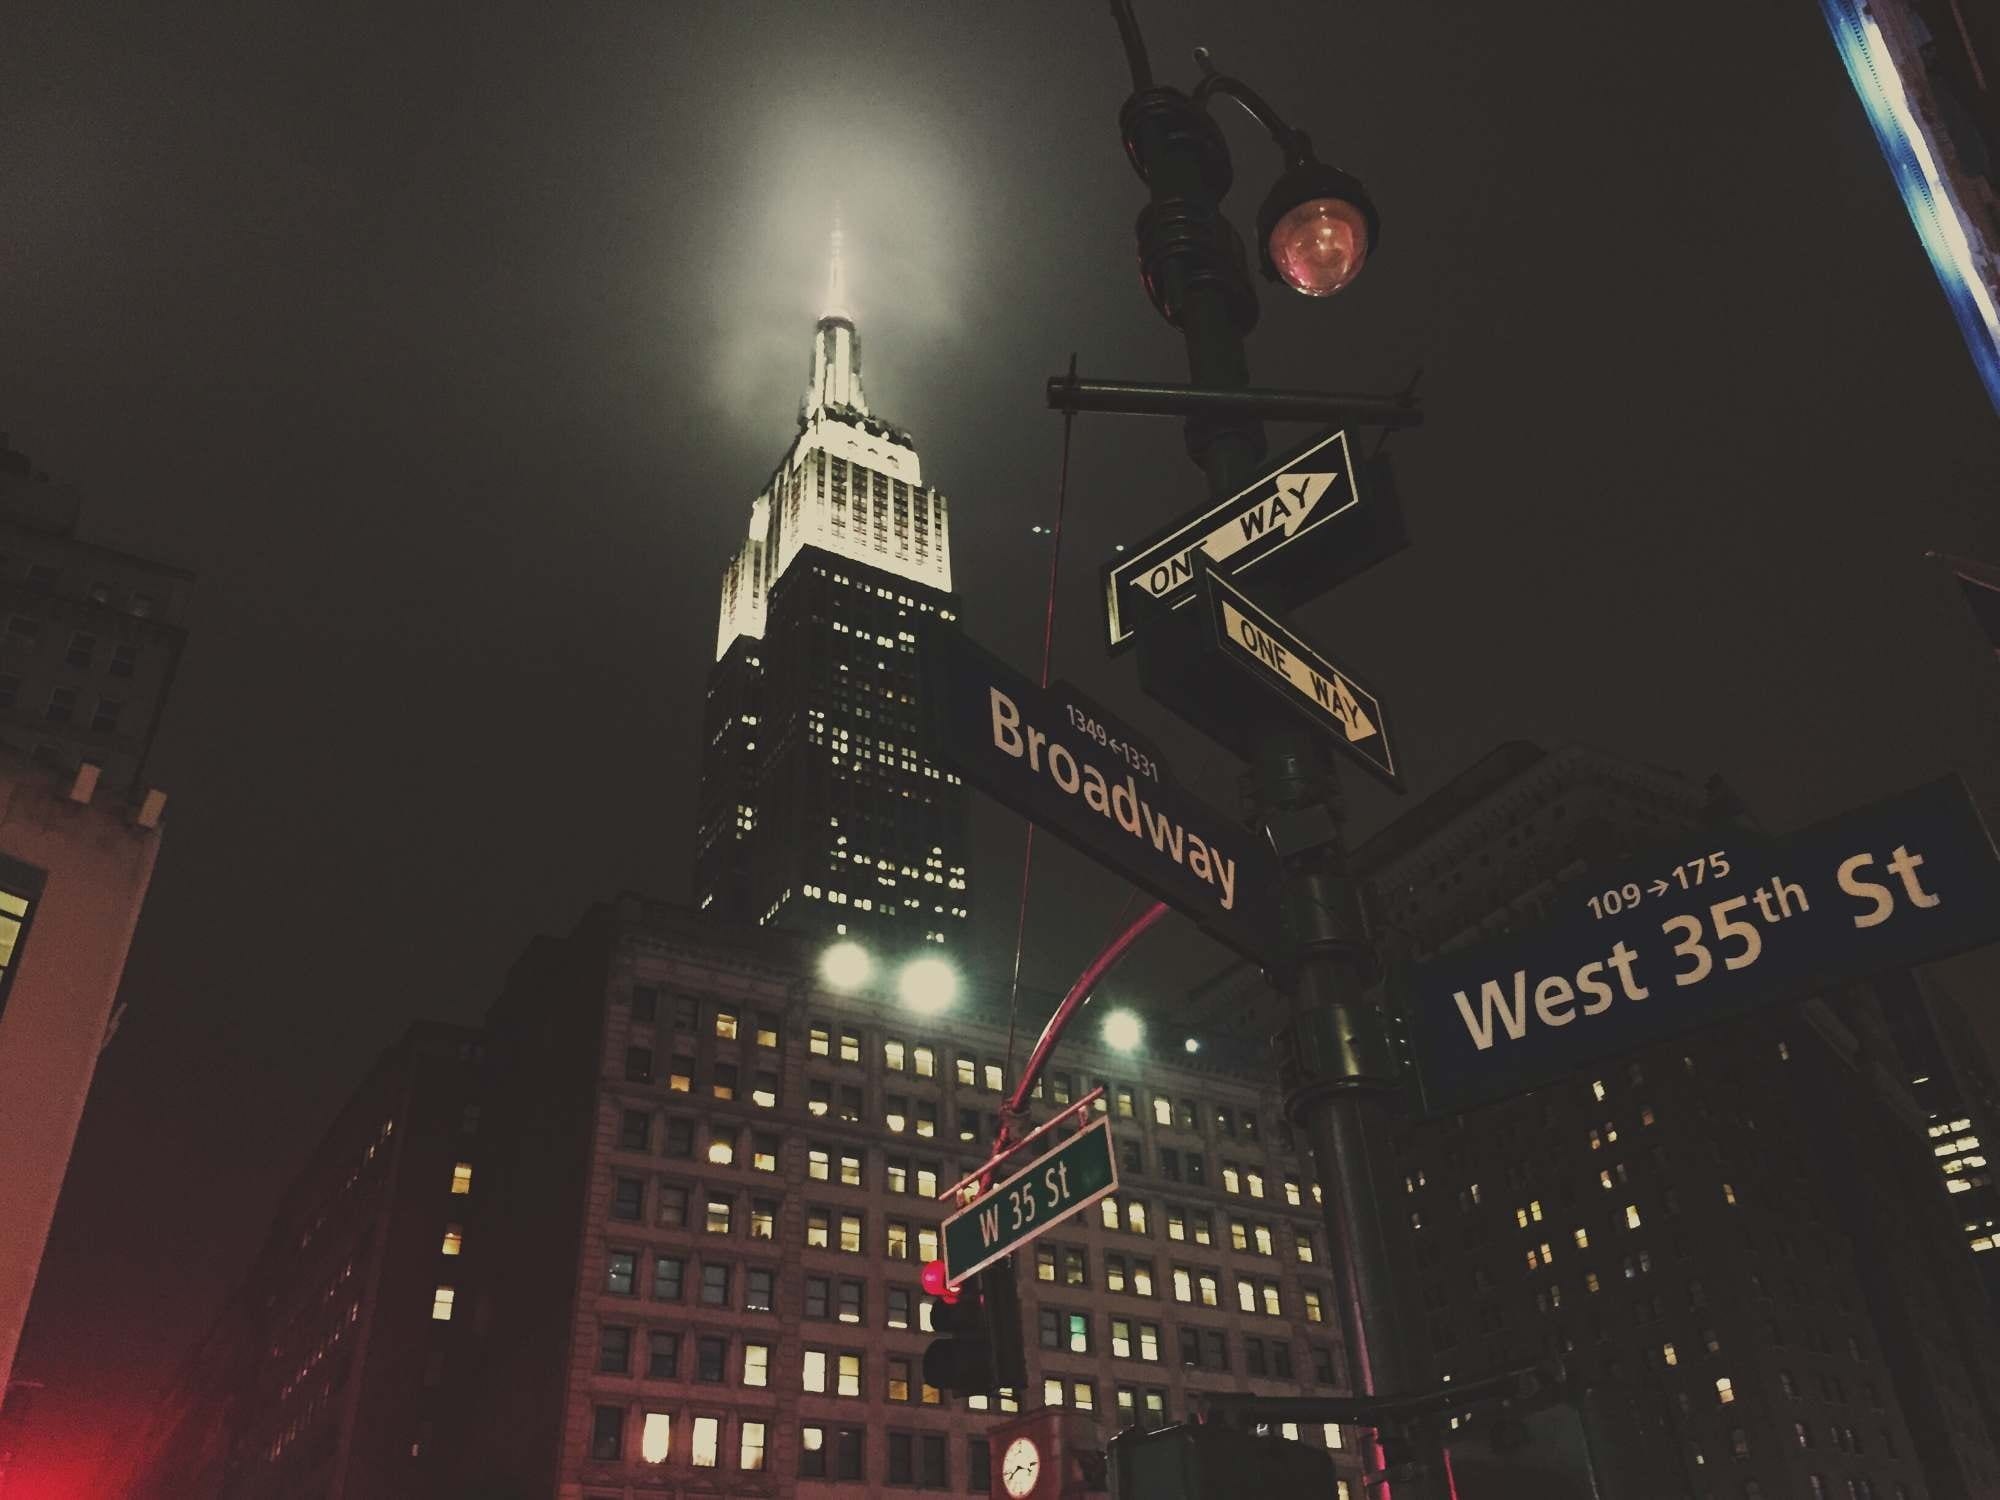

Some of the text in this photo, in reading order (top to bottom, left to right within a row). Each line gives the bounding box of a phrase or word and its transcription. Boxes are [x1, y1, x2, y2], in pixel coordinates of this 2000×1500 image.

[1150, 476, 1311, 595] ON WAY
[1240, 619, 1360, 729] ONE WAY
[989, 685, 1236, 911] Broadway
[1066, 704, 1158, 783] 1349 1331
[1587, 850, 1731, 920] 109 175
[1452, 844, 1941, 1051] West 35th St
[979, 1160, 1070, 1248] W 35 St
